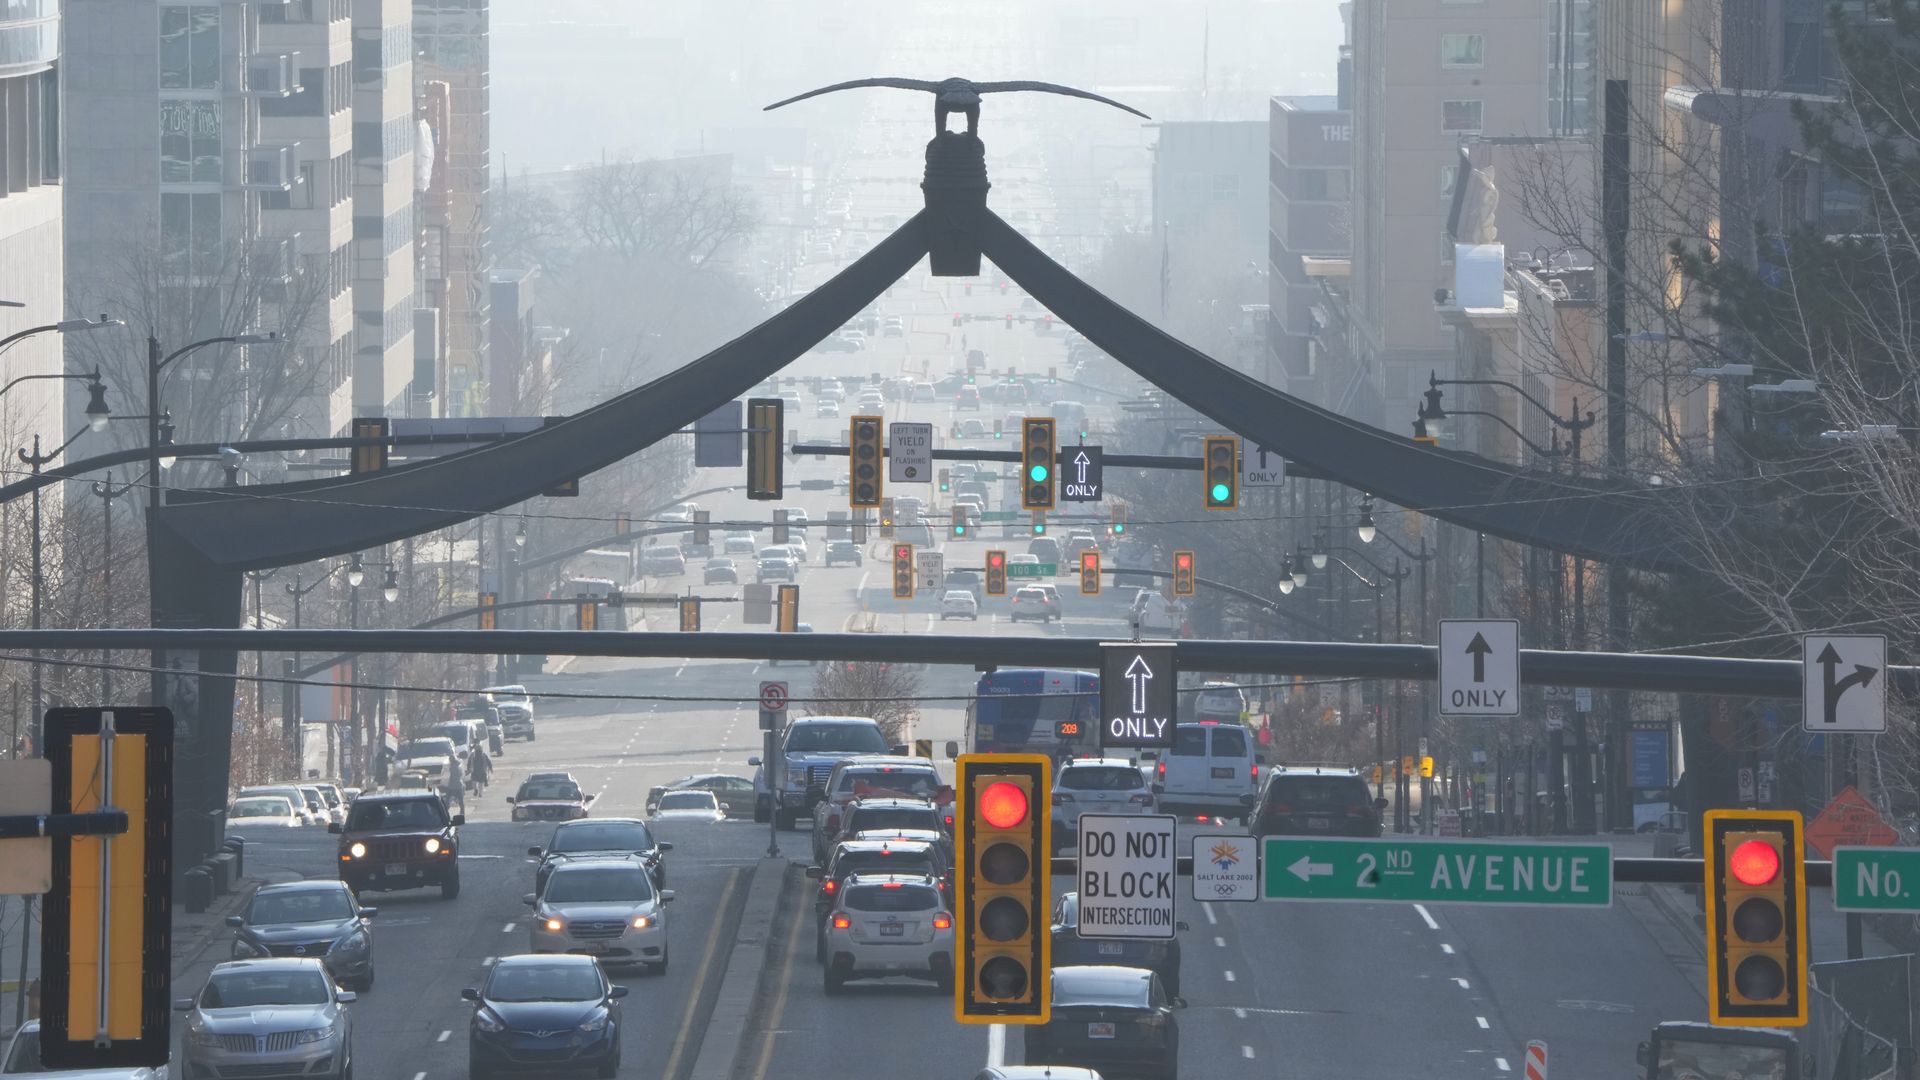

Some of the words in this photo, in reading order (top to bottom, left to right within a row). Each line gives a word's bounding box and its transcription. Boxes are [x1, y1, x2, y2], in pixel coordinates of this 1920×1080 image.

[1320, 125, 1350, 141] THE
[898, 437, 924, 446] YIELD
[1249, 472, 1277, 482] ONLY
[1066, 484, 1097, 496] ONLY
[1013, 566, 1029, 575] 100
[1452, 690, 1506, 707] ONLY
[1061, 723, 1078, 734] 209
[1111, 718, 1167, 737] ONLY
[1085, 831, 1116, 858] DO
[1126, 831, 1170, 858] NOT
[1430, 854, 1590, 893] AVENUE
[1084, 871, 1171, 899] BLOCK
[1083, 906, 1171, 926] INTERSECTION
